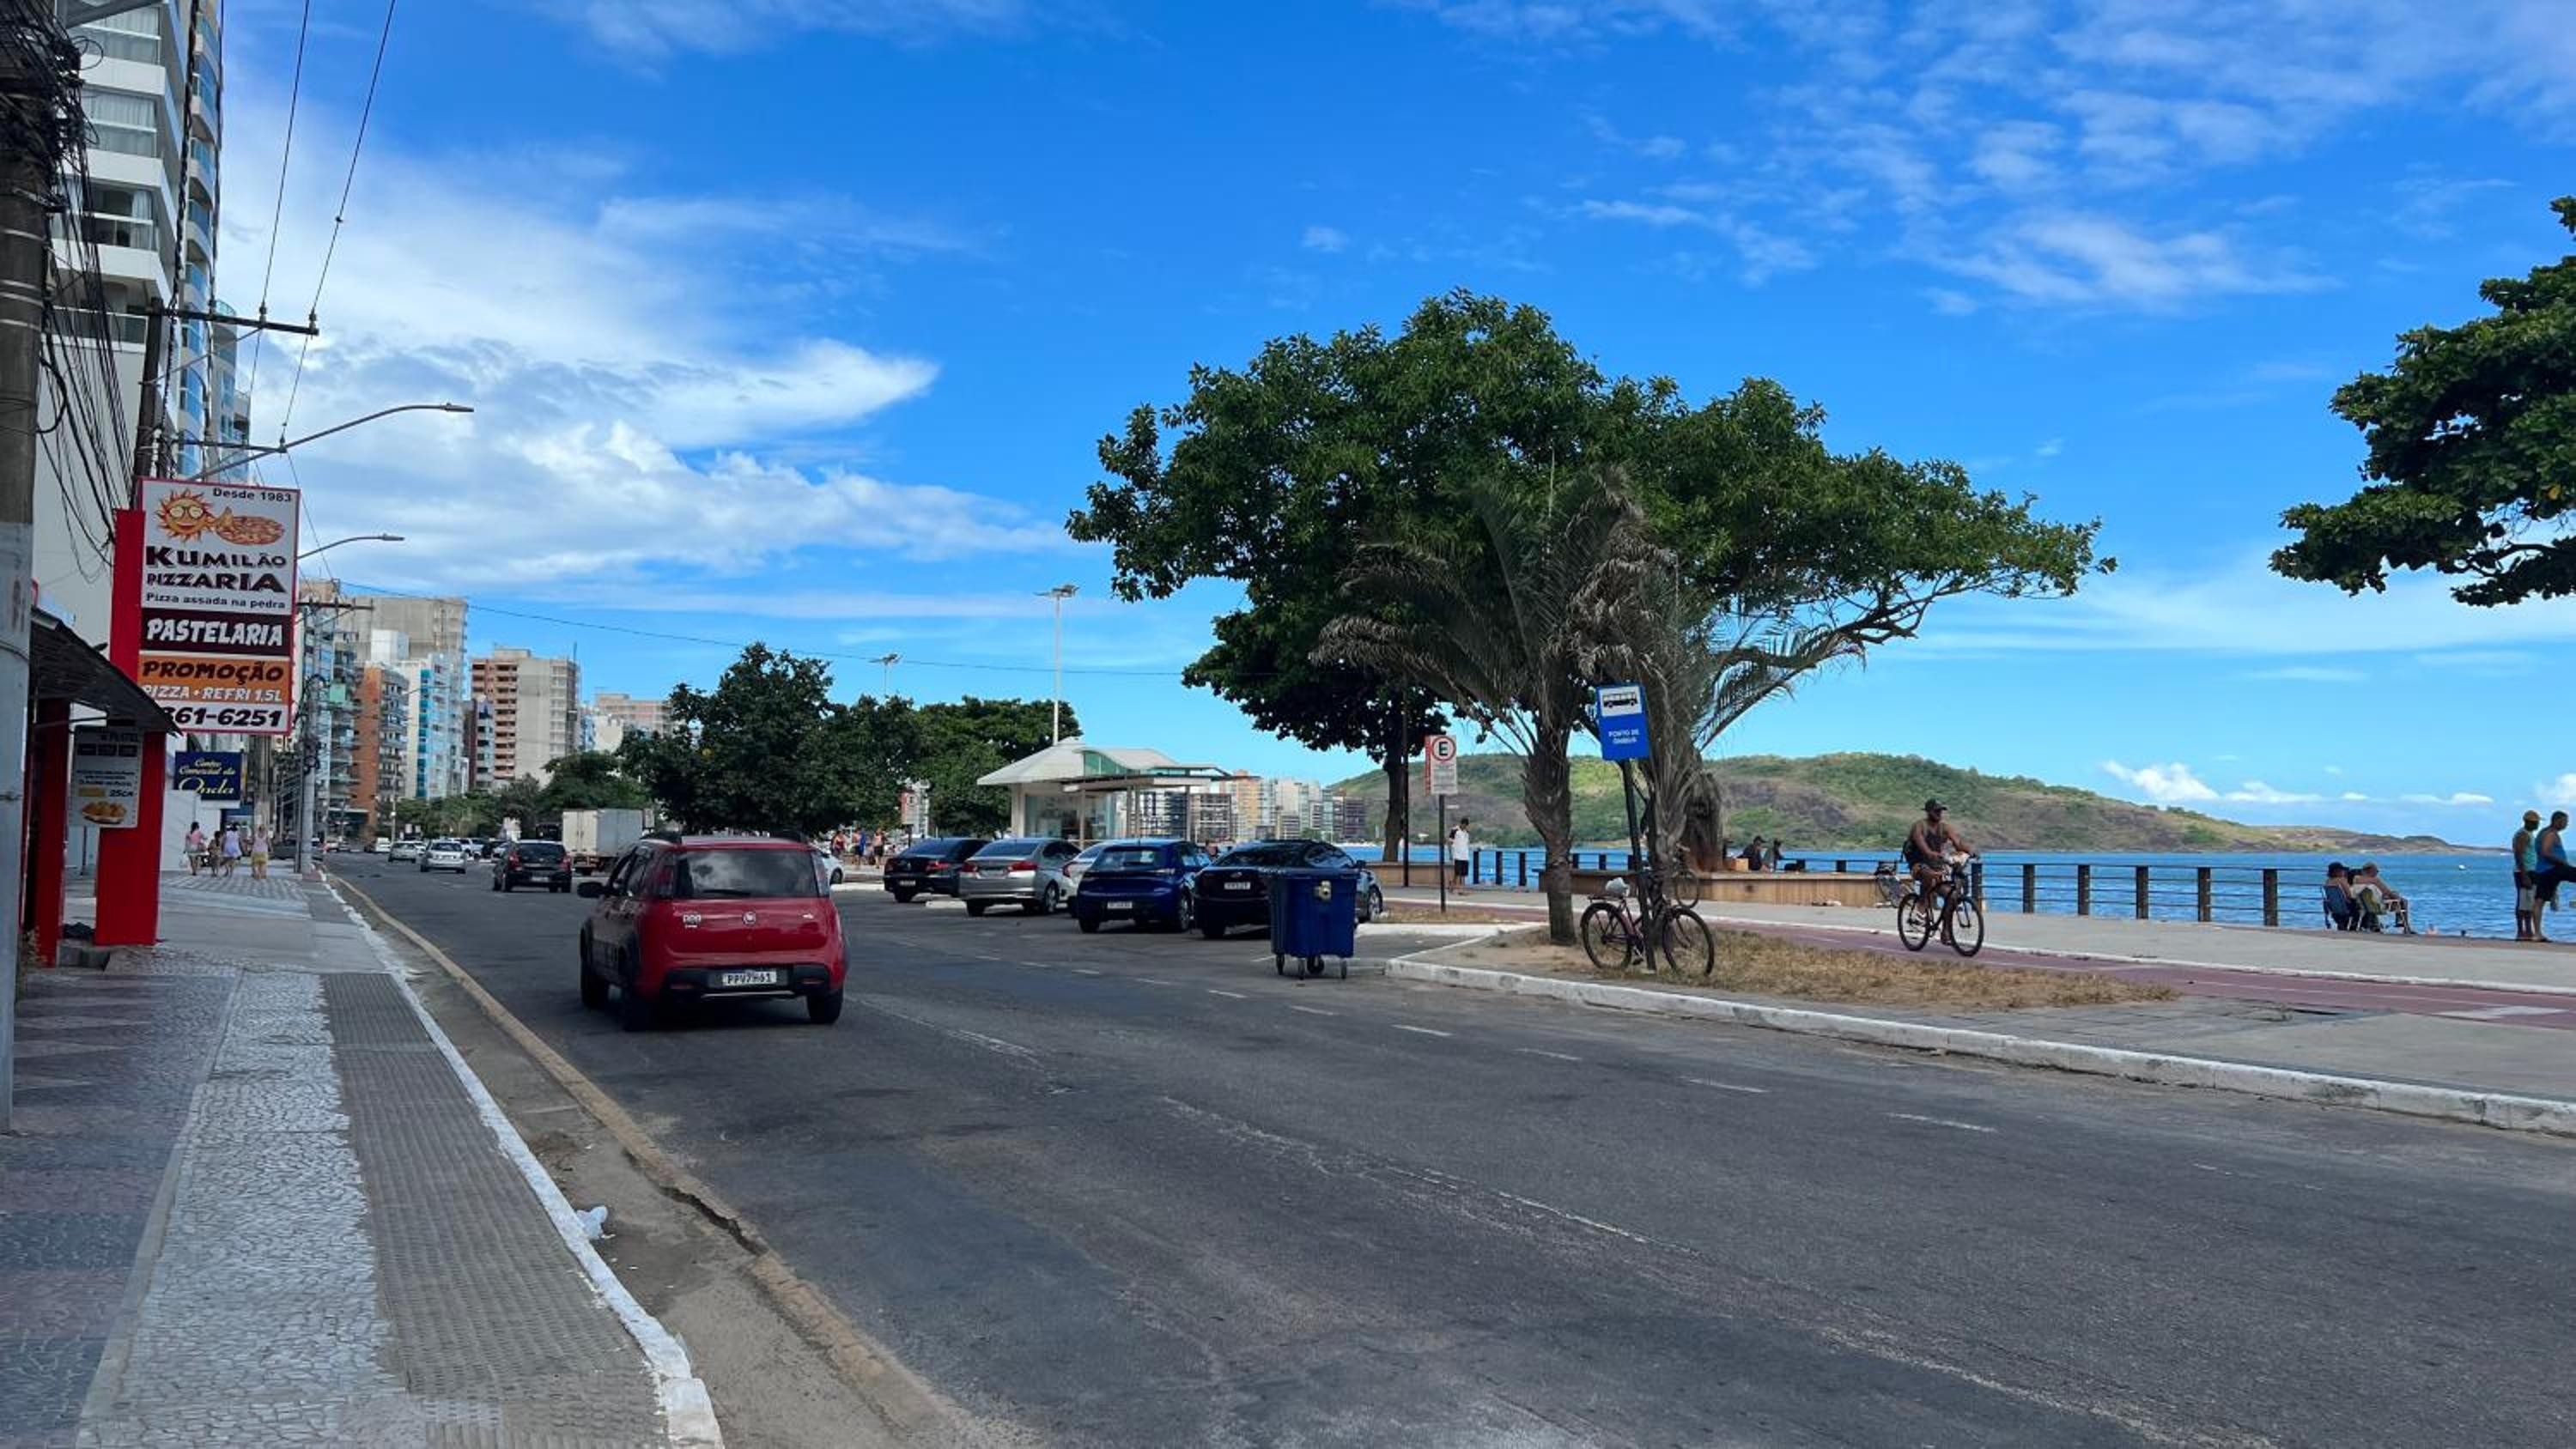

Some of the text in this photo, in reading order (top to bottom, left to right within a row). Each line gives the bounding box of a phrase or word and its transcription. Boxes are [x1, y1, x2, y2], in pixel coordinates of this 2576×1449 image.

[213, 487, 292, 502] Desde 1983
[147, 546, 286, 567] KUMILÃO
[147, 573, 287, 593] PIZZARIA
[147, 593, 286, 609] Pizza assada na pedra
[147, 618, 283, 646] PASTELARIA
[143, 661, 283, 685] PROMOÇÃO
[203, 688, 250, 700] REFRI
[1439, 742, 1449, 755] E
